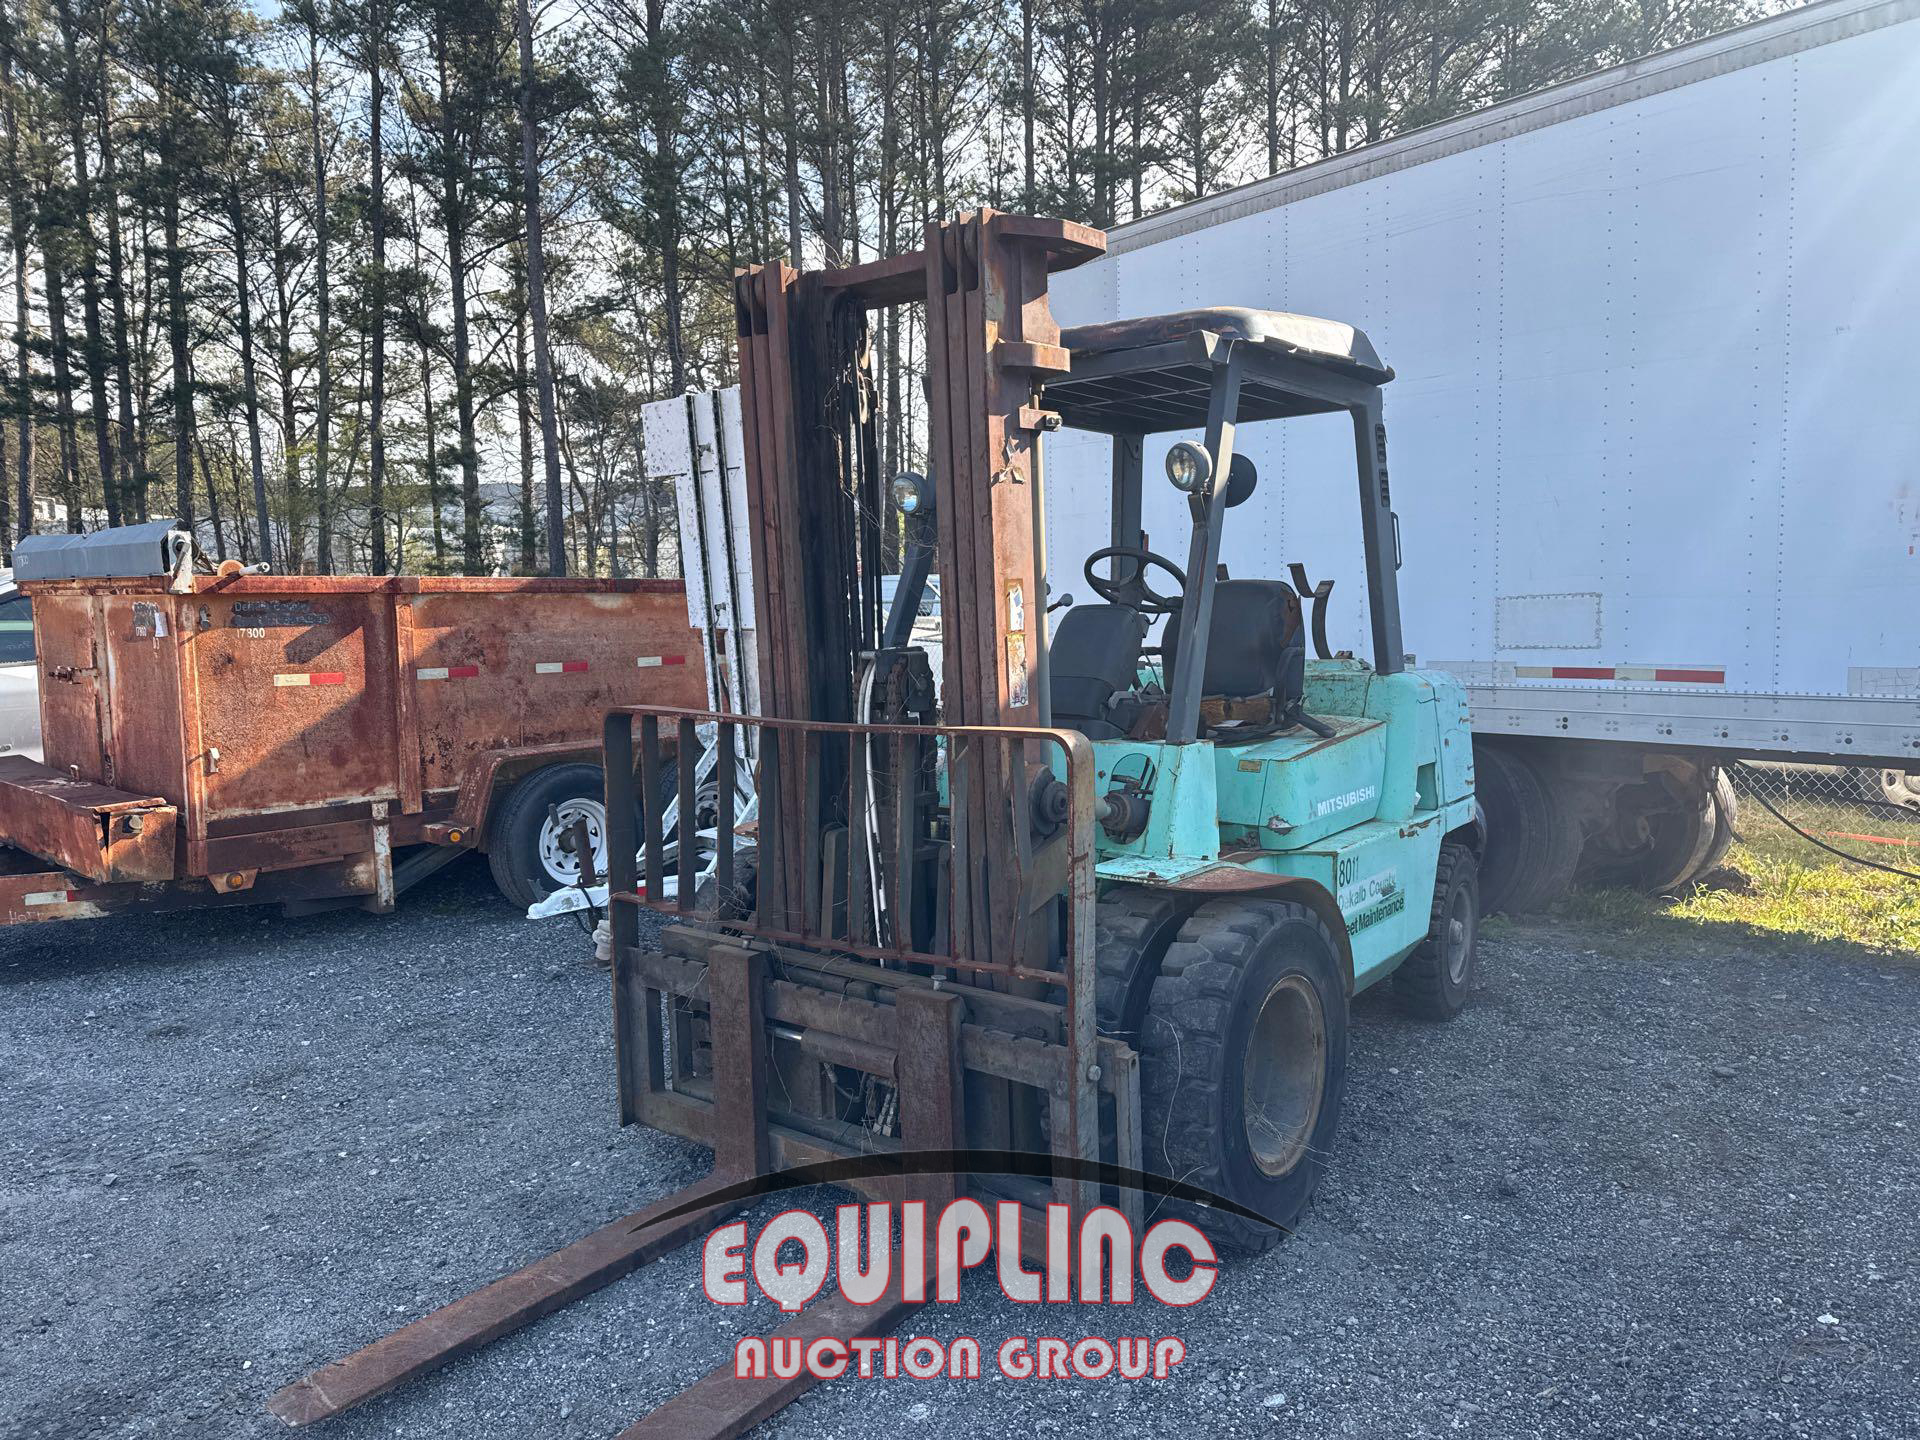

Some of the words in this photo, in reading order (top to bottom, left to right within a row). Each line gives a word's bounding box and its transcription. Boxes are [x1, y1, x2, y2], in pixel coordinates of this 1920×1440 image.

[237, 627, 266, 639] 17800
[1317, 785, 1375, 817] MITSUBISHI
[1338, 856, 1359, 888] 8011
[1345, 917, 1358, 936] eet
[1358, 897, 1404, 932] Maintenance
